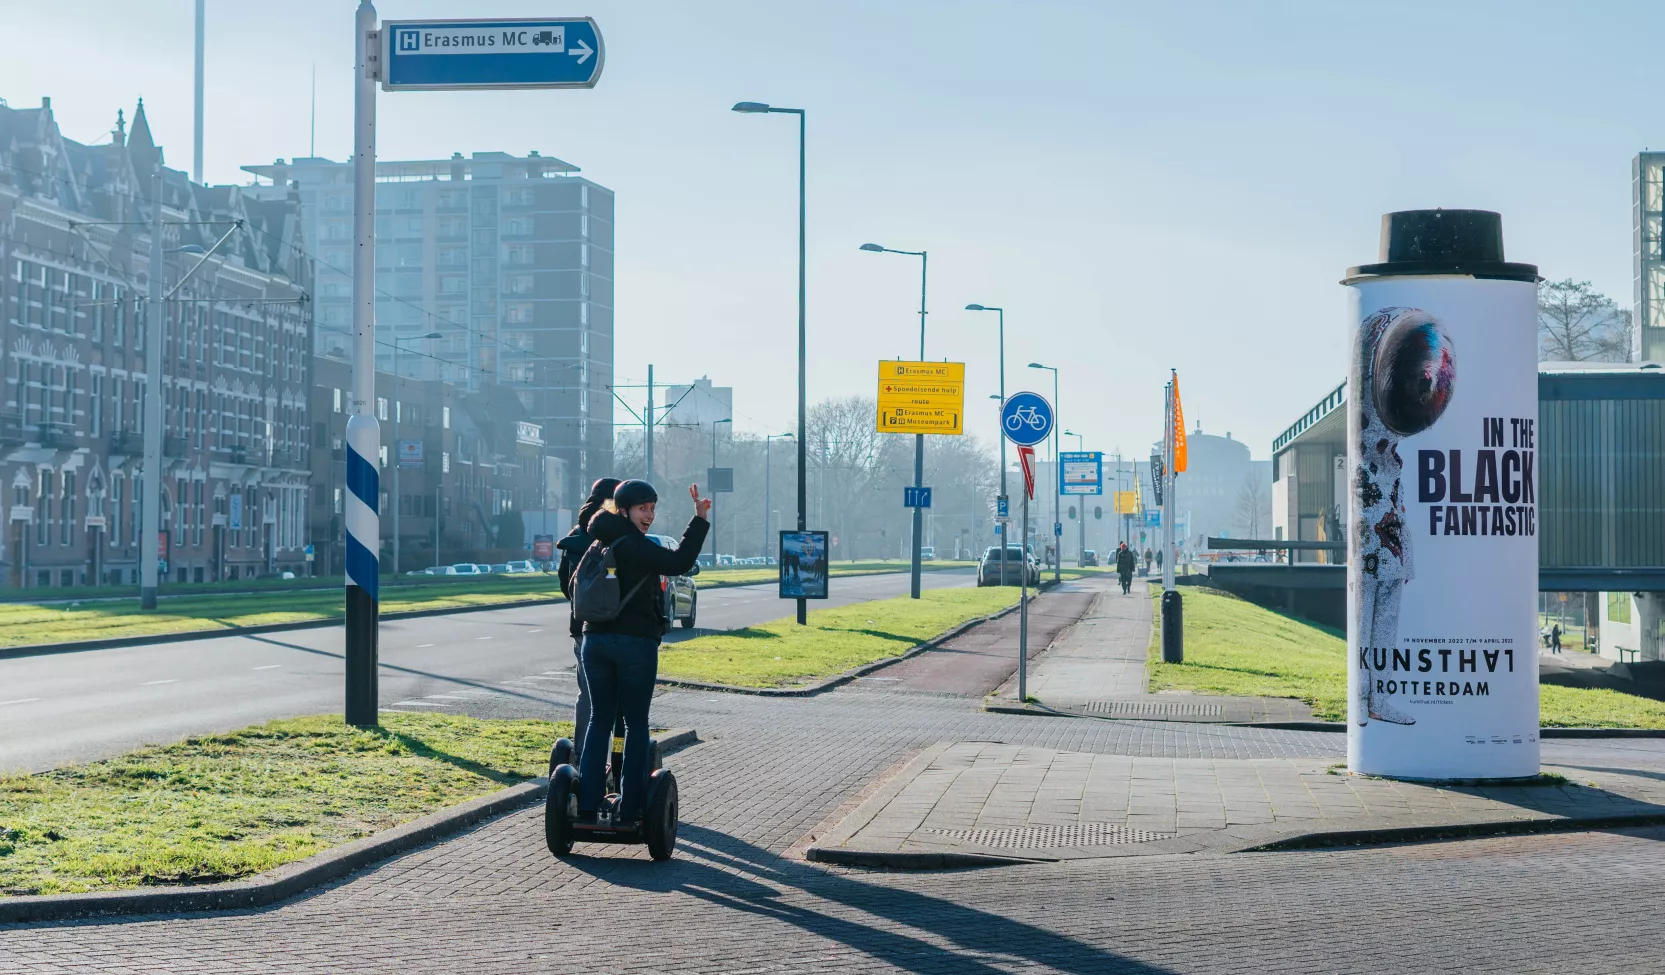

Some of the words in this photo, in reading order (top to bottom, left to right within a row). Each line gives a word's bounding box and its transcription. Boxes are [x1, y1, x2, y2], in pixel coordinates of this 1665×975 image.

[424, 33, 495, 47] Erasmus
[502, 31, 528, 46] MC
[907, 418, 950, 426] Museumpark
[1483, 417, 1504, 447] IN
[1510, 417, 1534, 448] THE
[1337, 458, 1344, 468] 2
[1418, 449, 1535, 504] BLACK
[1000, 502, 1006, 510] P
[1429, 505, 1535, 536] FANTASTIC
[1377, 679, 1490, 696] ROTTERDAM
